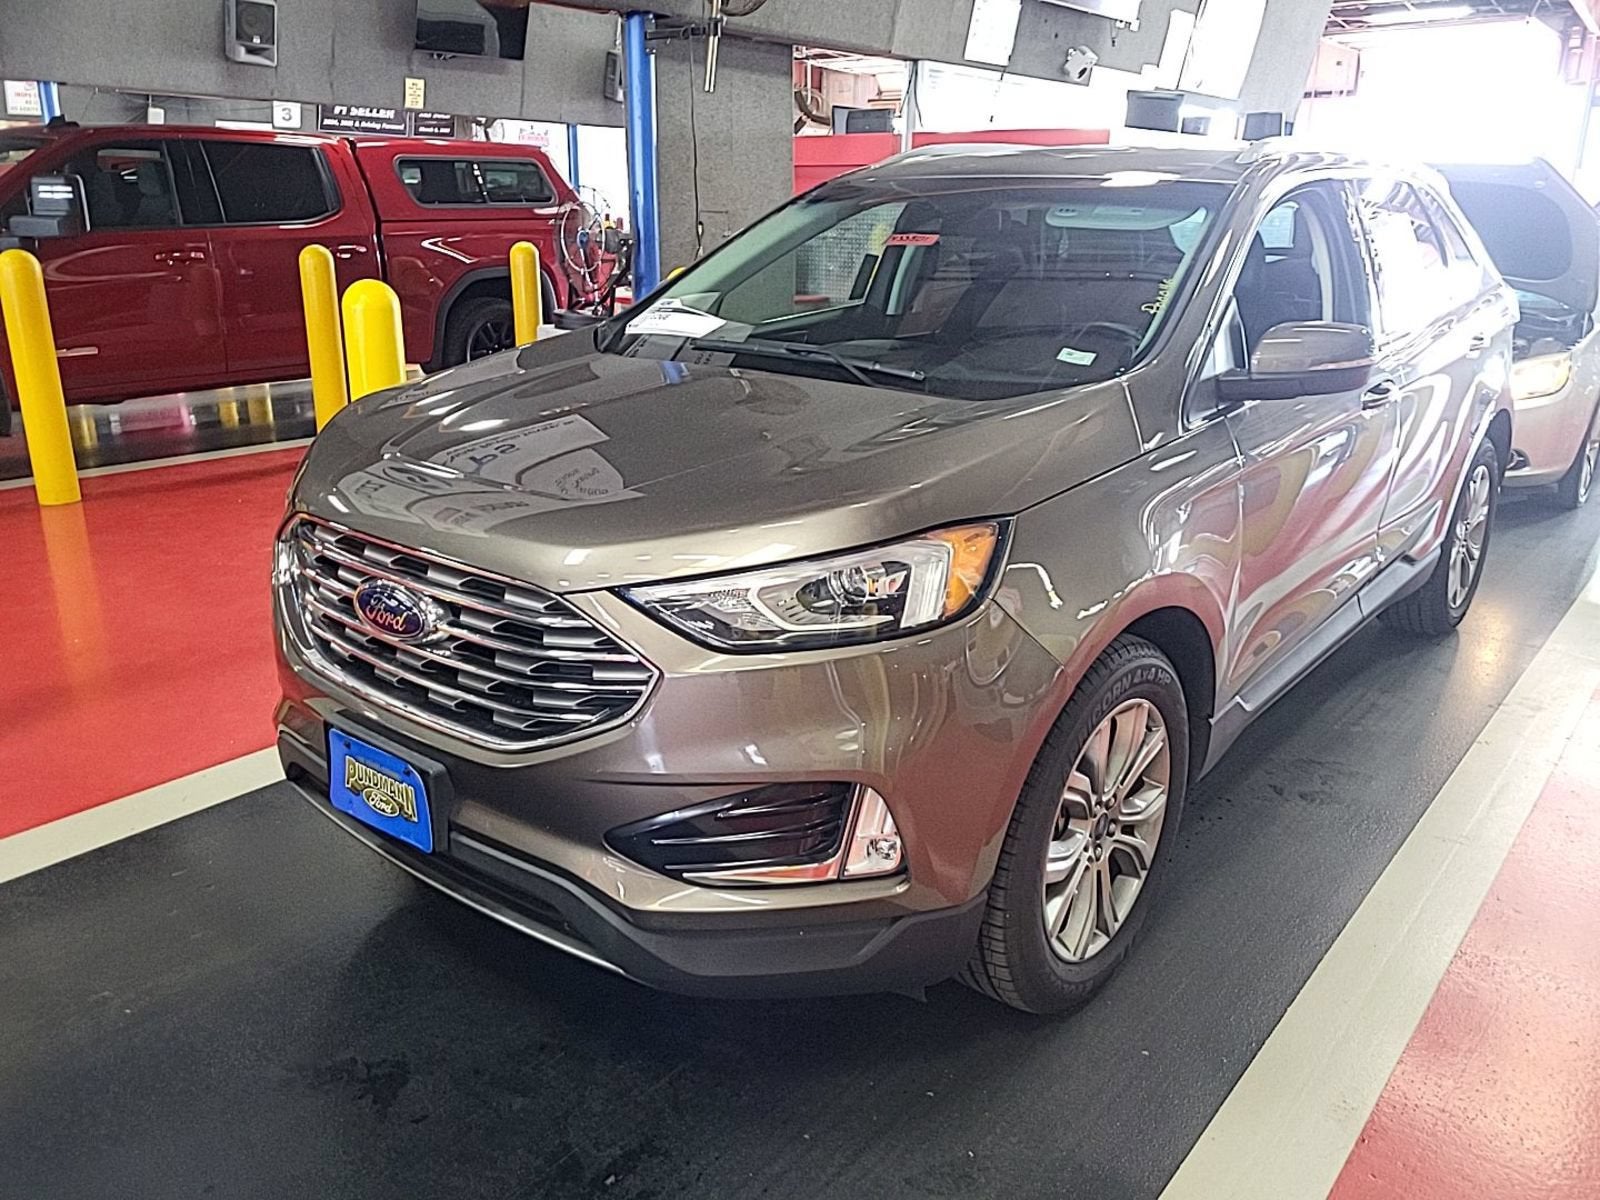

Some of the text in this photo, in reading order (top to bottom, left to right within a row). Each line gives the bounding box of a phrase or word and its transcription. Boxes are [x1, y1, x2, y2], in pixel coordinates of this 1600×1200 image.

[281, 107, 293, 122] 3
[366, 594, 406, 631] Ford
[345, 755, 418, 823] PUNDMANN
[368, 791, 393, 814] Ford
